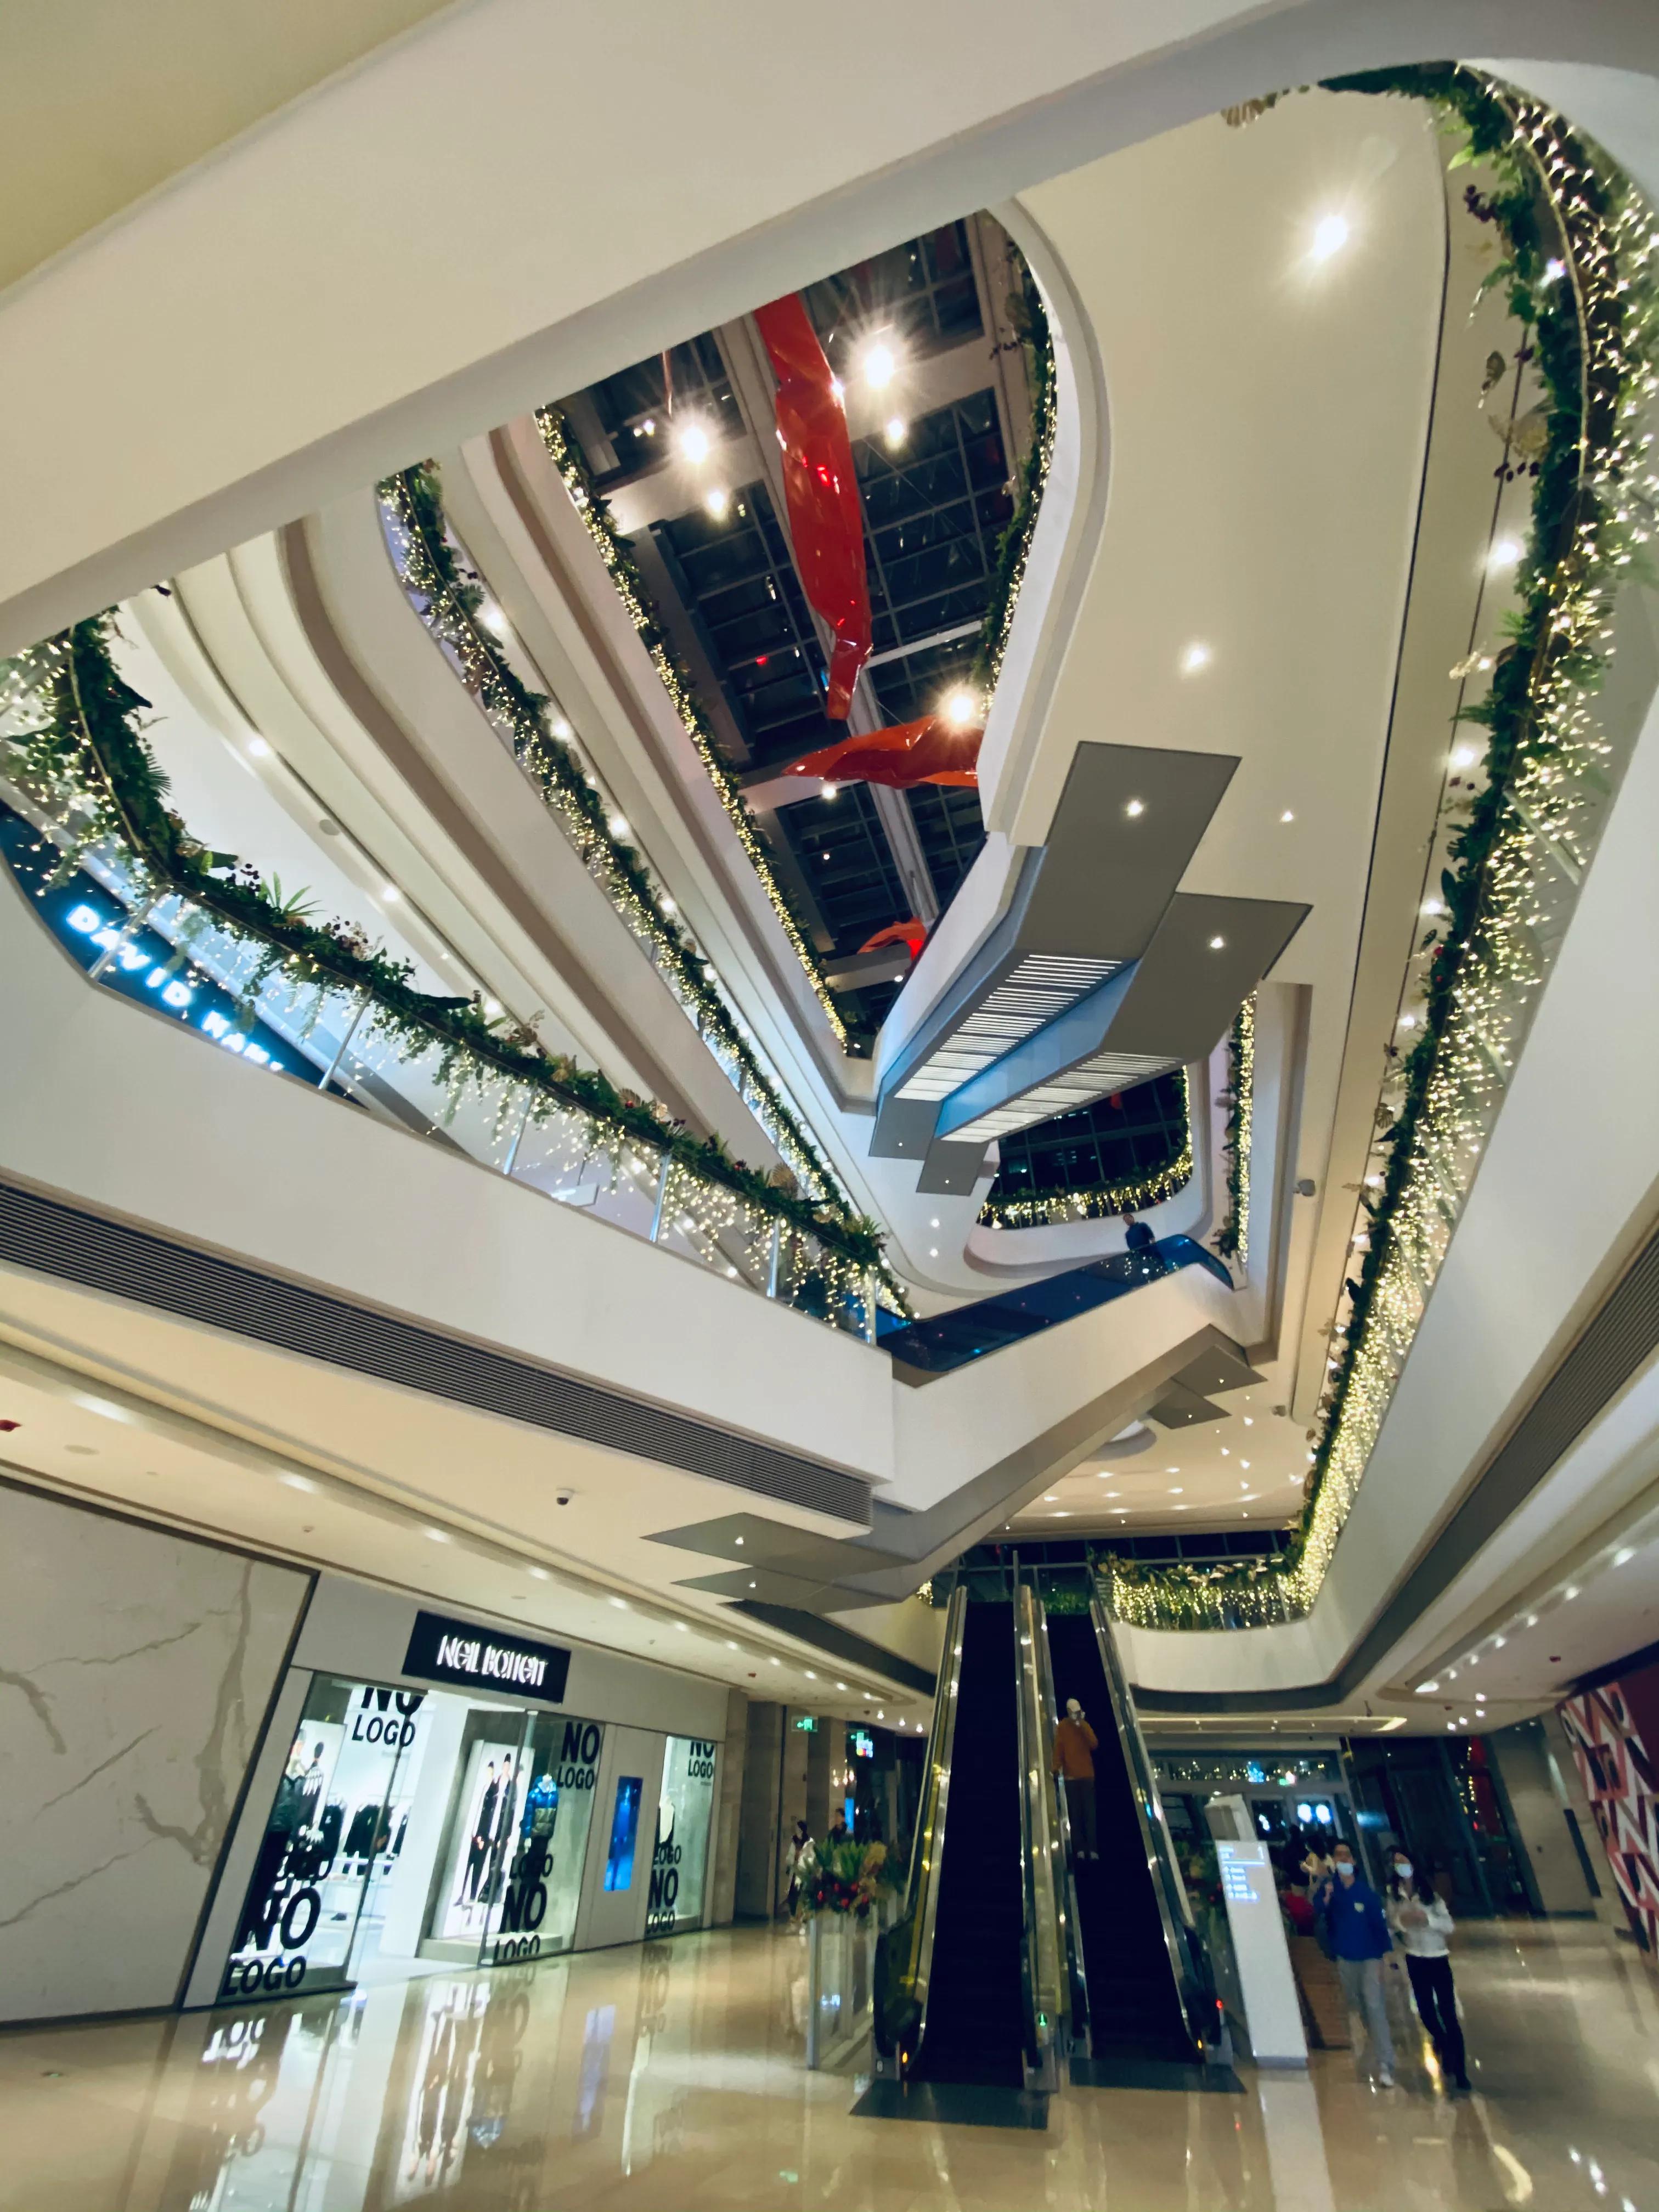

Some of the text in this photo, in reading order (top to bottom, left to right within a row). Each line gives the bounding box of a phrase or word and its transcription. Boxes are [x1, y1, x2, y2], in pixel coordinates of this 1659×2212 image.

[66, 905, 193, 1007] DAVID
[352, 1714, 416, 1747] LOGO
[561, 1721, 600, 1764] NO
[556, 1765, 595, 1790] LOGO
[688, 1759, 713, 1779] LOGO
[498, 1882, 547, 1933] NO
[648, 1867, 678, 1909] NO
[234, 1887, 321, 1950] NO
[221, 1955, 306, 1996] LOGO
